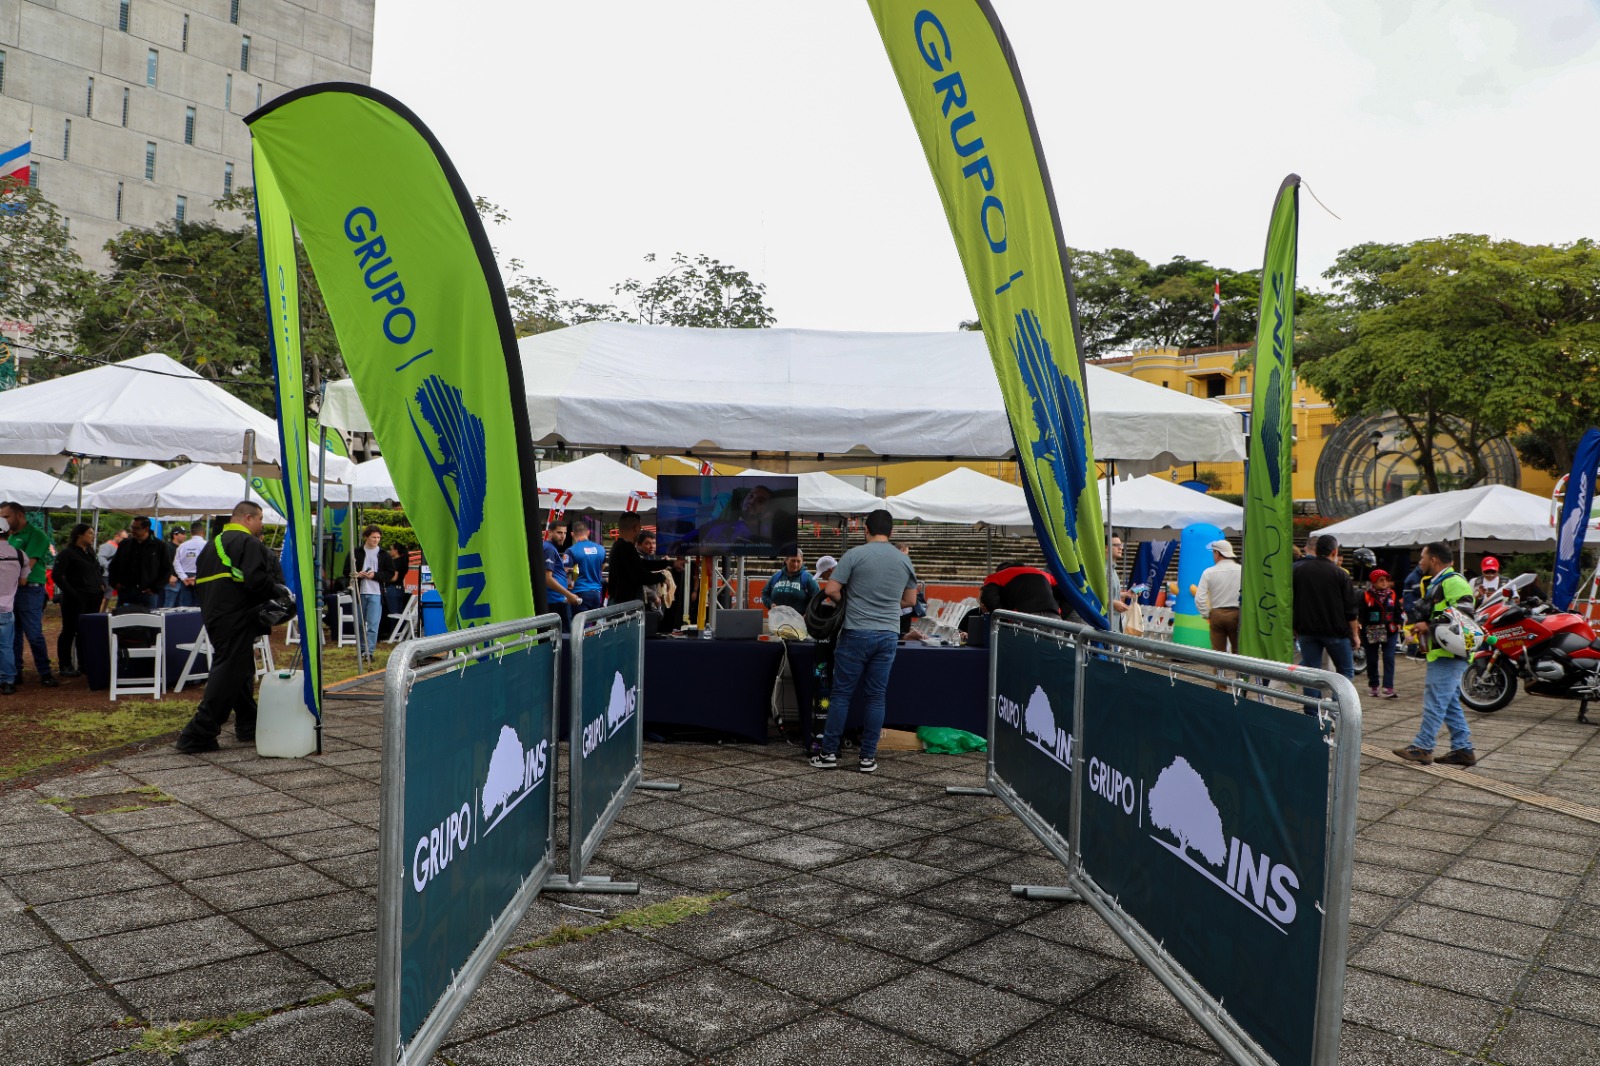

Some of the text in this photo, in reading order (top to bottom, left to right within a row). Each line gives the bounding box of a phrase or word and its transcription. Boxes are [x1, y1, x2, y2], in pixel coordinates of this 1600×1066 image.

[914, 9, 1007, 254] GRUPO
[344, 206, 416, 345] GRUPO
[582, 685, 636, 759] GRUPO INS
[997, 694, 1073, 766] GRUPO IN
[412, 739, 548, 893] GRUPO INS
[1088, 756, 1300, 924] GRUPO INS
